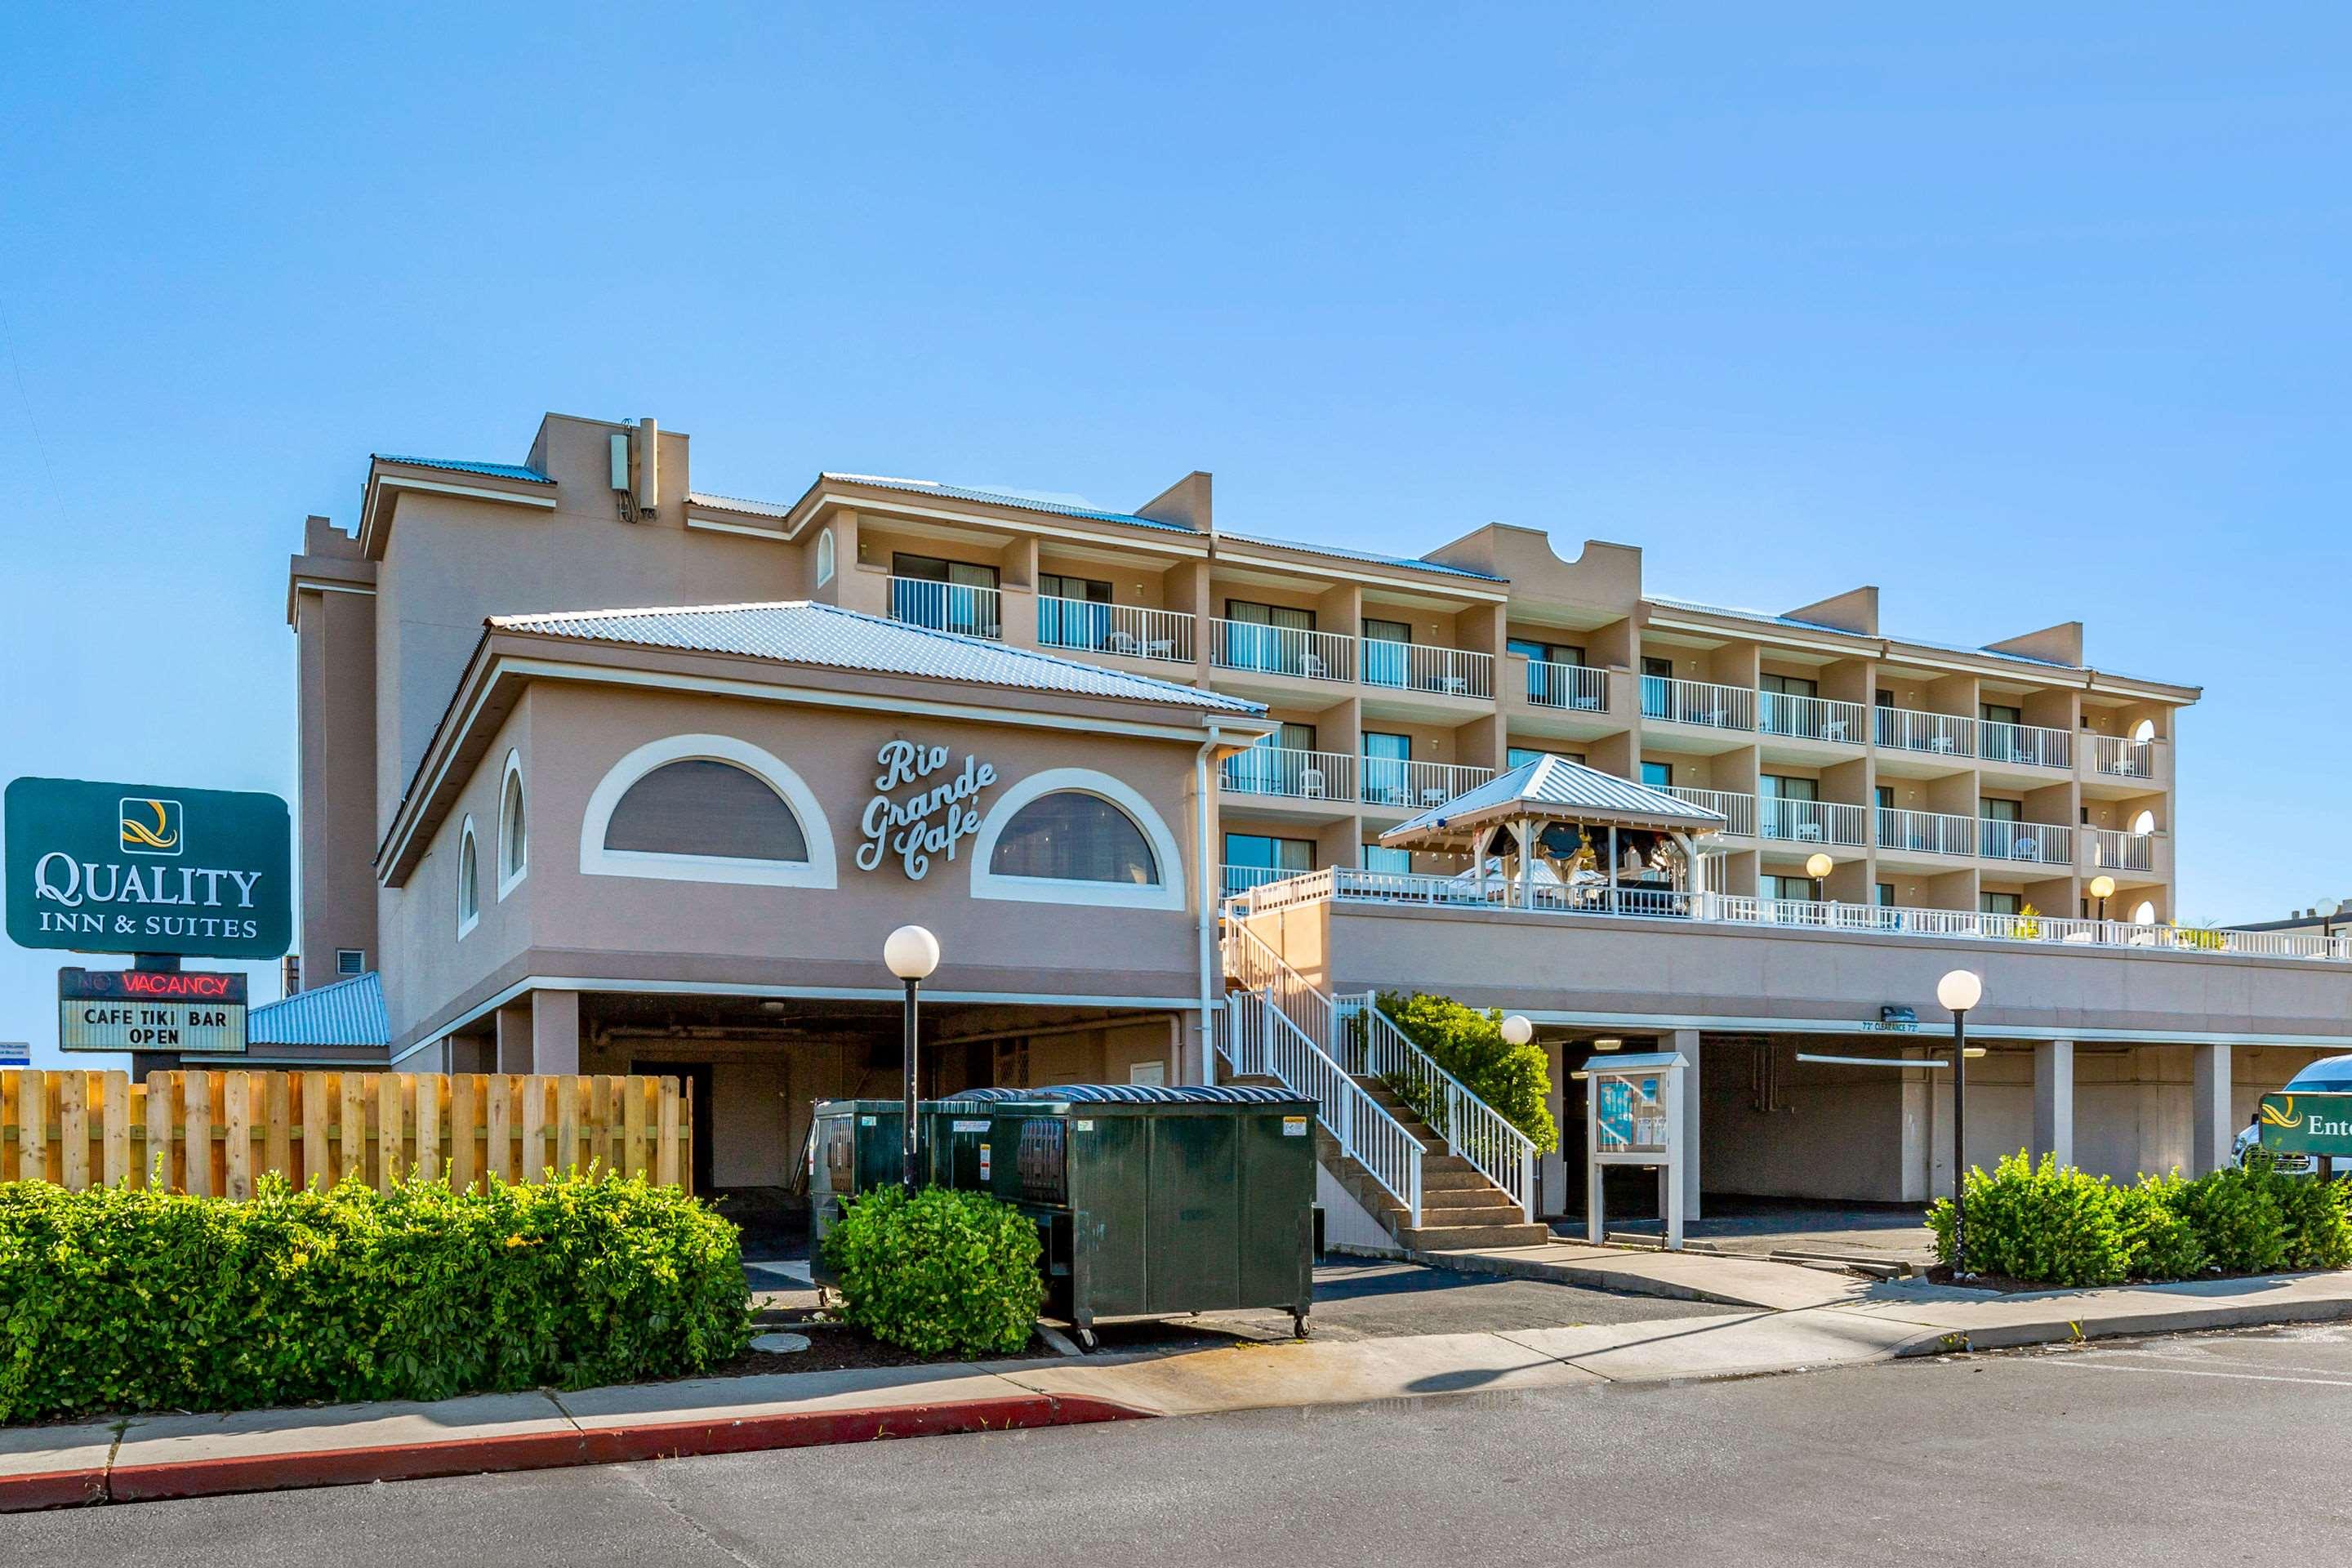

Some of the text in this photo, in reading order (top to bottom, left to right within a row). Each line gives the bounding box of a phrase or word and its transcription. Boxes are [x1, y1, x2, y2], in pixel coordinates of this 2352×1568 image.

[875, 739, 949, 791] Rio
[856, 754, 997, 871] Grande
[893, 795, 982, 880] Café
[35, 852, 262, 908] QUALITY
[39, 912, 257, 938] INN & SUITES
[123, 974, 229, 995] VACANCY
[84, 1009, 226, 1027] CAFE TIKI BAR
[1875, 1022, 1905, 1031] CLEARANCE
[129, 1028, 178, 1044] OPEN
